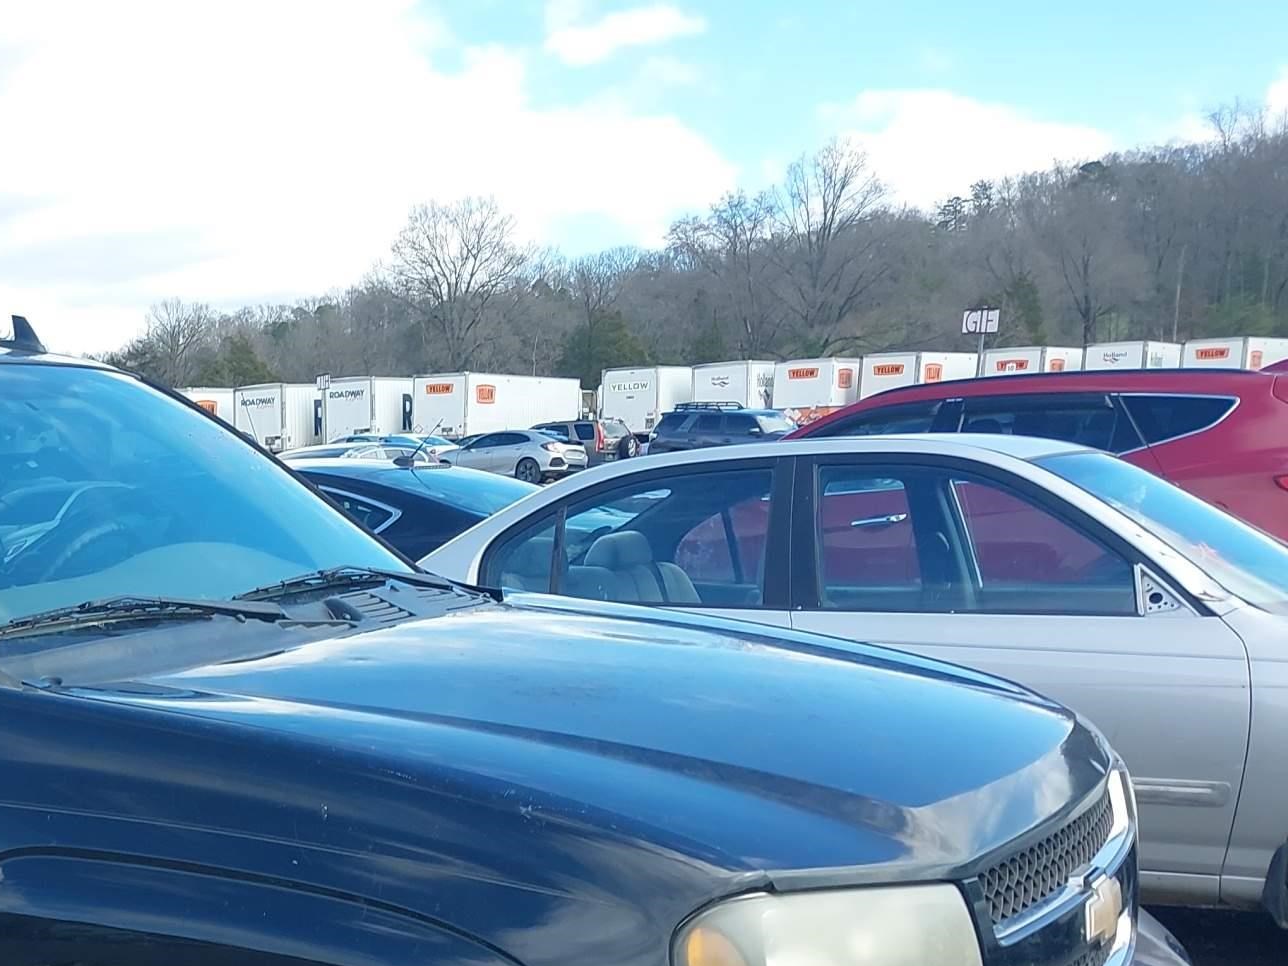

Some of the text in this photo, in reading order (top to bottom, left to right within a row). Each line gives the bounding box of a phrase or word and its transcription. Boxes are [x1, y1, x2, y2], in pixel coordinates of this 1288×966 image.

[1199, 349, 1227, 359] YELLOW
[791, 368, 816, 378] YELLOW
[877, 365, 900, 375] YELLOW
[429, 384, 451, 393] YELLOW
[611, 382, 649, 391] YELLOW
[329, 390, 364, 399] ROADWAY
[240, 397, 275, 407] ROADWAY
